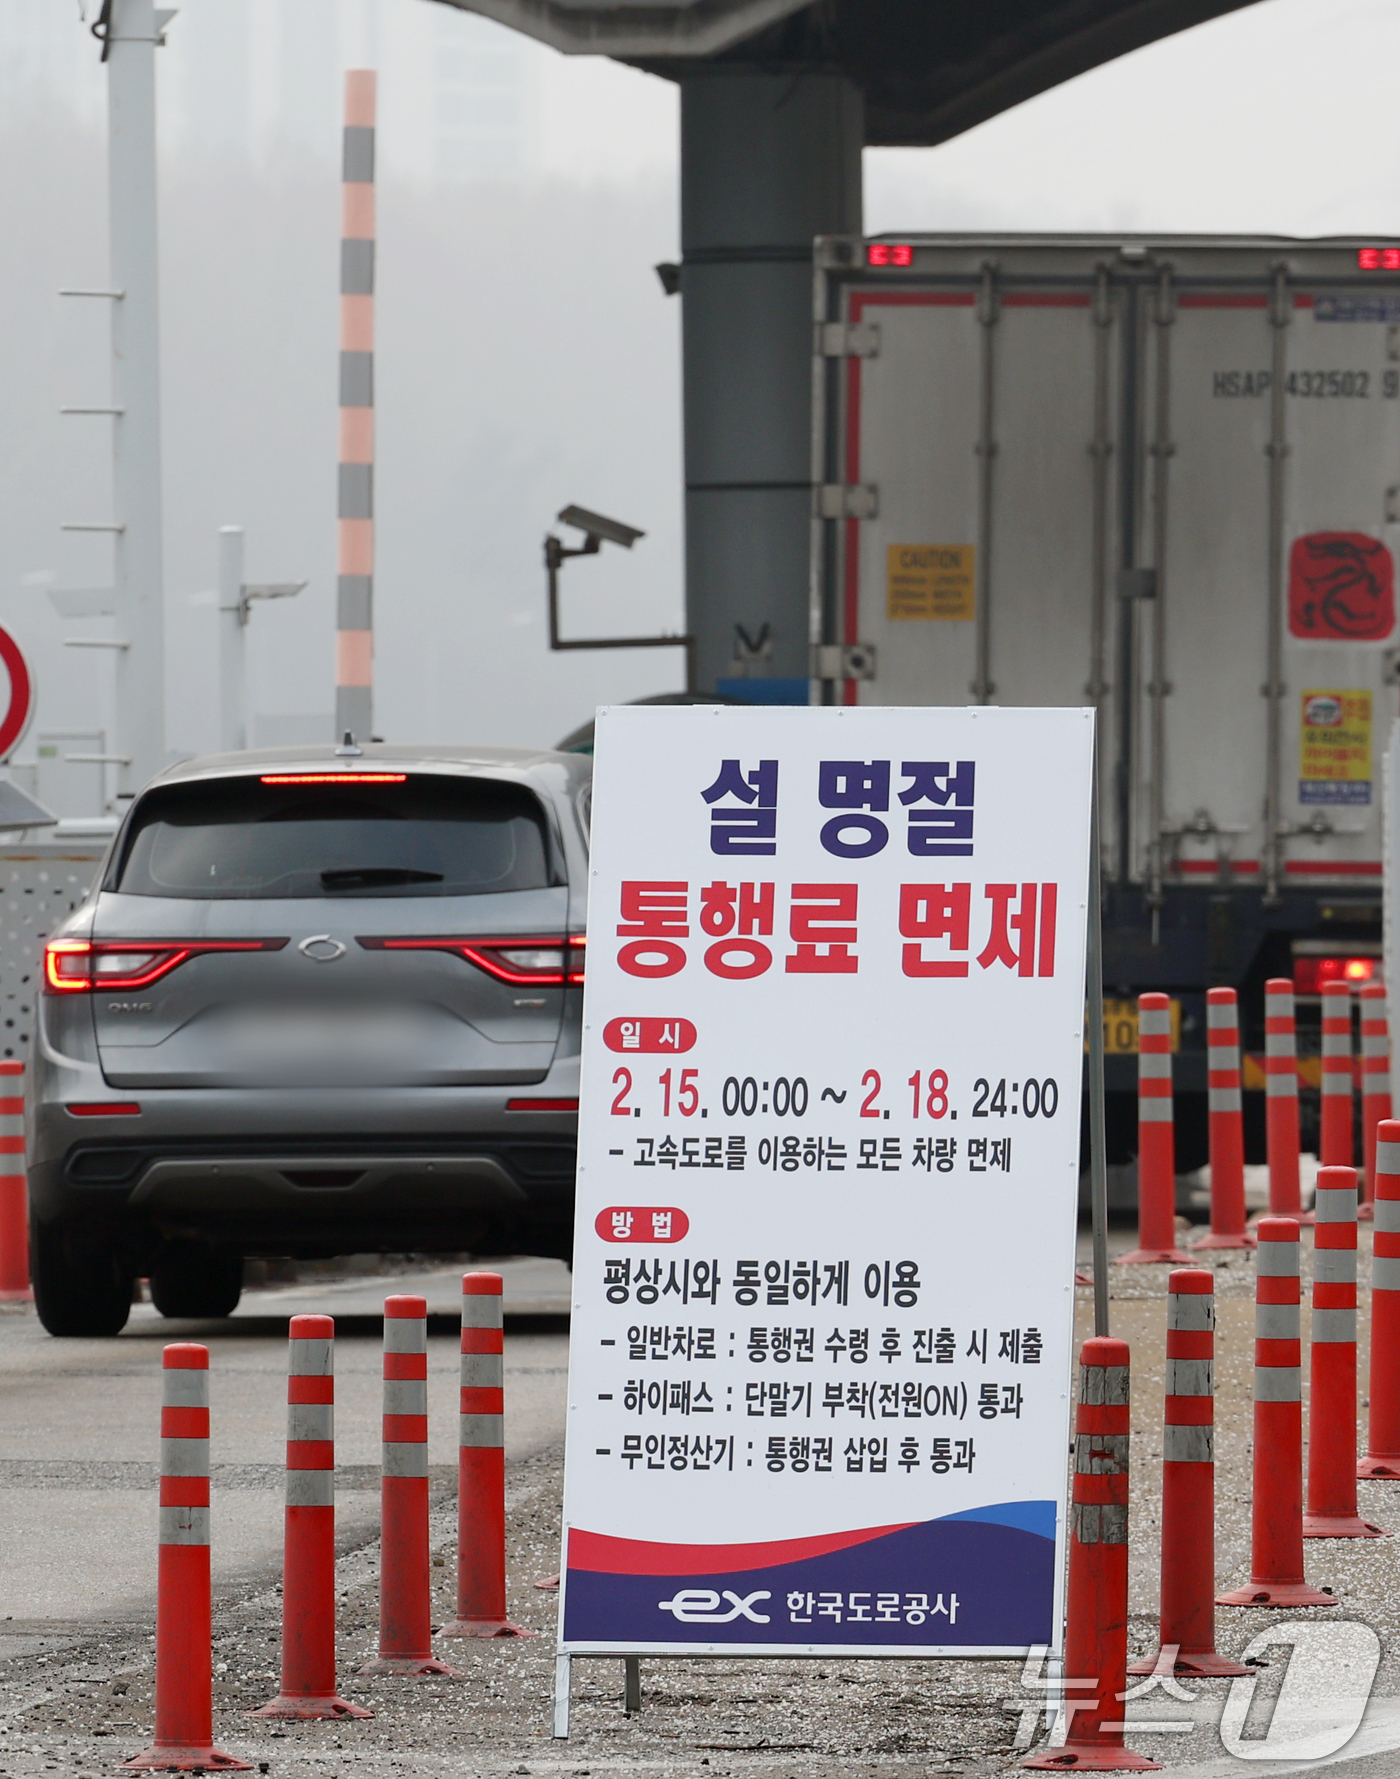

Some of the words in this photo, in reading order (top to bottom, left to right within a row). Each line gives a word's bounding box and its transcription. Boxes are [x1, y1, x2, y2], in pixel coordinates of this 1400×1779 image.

[1212, 370, 1271, 398] HSAP
[1284, 370, 1370, 399] 432502
[700, 759, 779, 856] 설
[818, 759, 976, 859] 명절
[616, 880, 859, 980] 통행료
[898, 882, 1058, 978] 면제
[610, 1066, 641, 1118] 2.
[658, 1067, 708, 1119] 15.
[722, 1076, 809, 1118] 00:00
[859, 1068, 890, 1120] 2.
[908, 1068, 958, 1121] 18.
[971, 1077, 1059, 1119] 24:00
[633, 1134, 748, 1171] 고속도로를
[758, 1135, 848, 1172] 이용하는
[856, 1137, 903, 1172] 모든
[911, 1136, 958, 1173] 차량
[967, 1137, 1012, 1173] 면제
[603, 1257, 721, 1306] 평상시와
[732, 1259, 850, 1307] 동일하게
[864, 1260, 921, 1308] 이용
[627, 1325, 717, 1362] 일반차로
[746, 1326, 815, 1364] 통행권
[824, 1327, 869, 1364] 수령
[879, 1327, 902, 1364] 후
[912, 1327, 957, 1364] 진출
[965, 1328, 988, 1365] 시
[997, 1327, 1044, 1365] 제출
[623, 1378, 714, 1416] 하이패스
[745, 1381, 812, 1418] 단말기
[822, 1380, 968, 1421] 부착(전원ON)
[977, 1382, 1024, 1420] 통과
[620, 1434, 734, 1472] 무인정산기
[765, 1436, 833, 1473] 통행권
[843, 1436, 888, 1473] 삽입
[897, 1436, 921, 1474] 후
[929, 1437, 976, 1475] 통과
[786, 1590, 960, 1625] 한국도로공사
